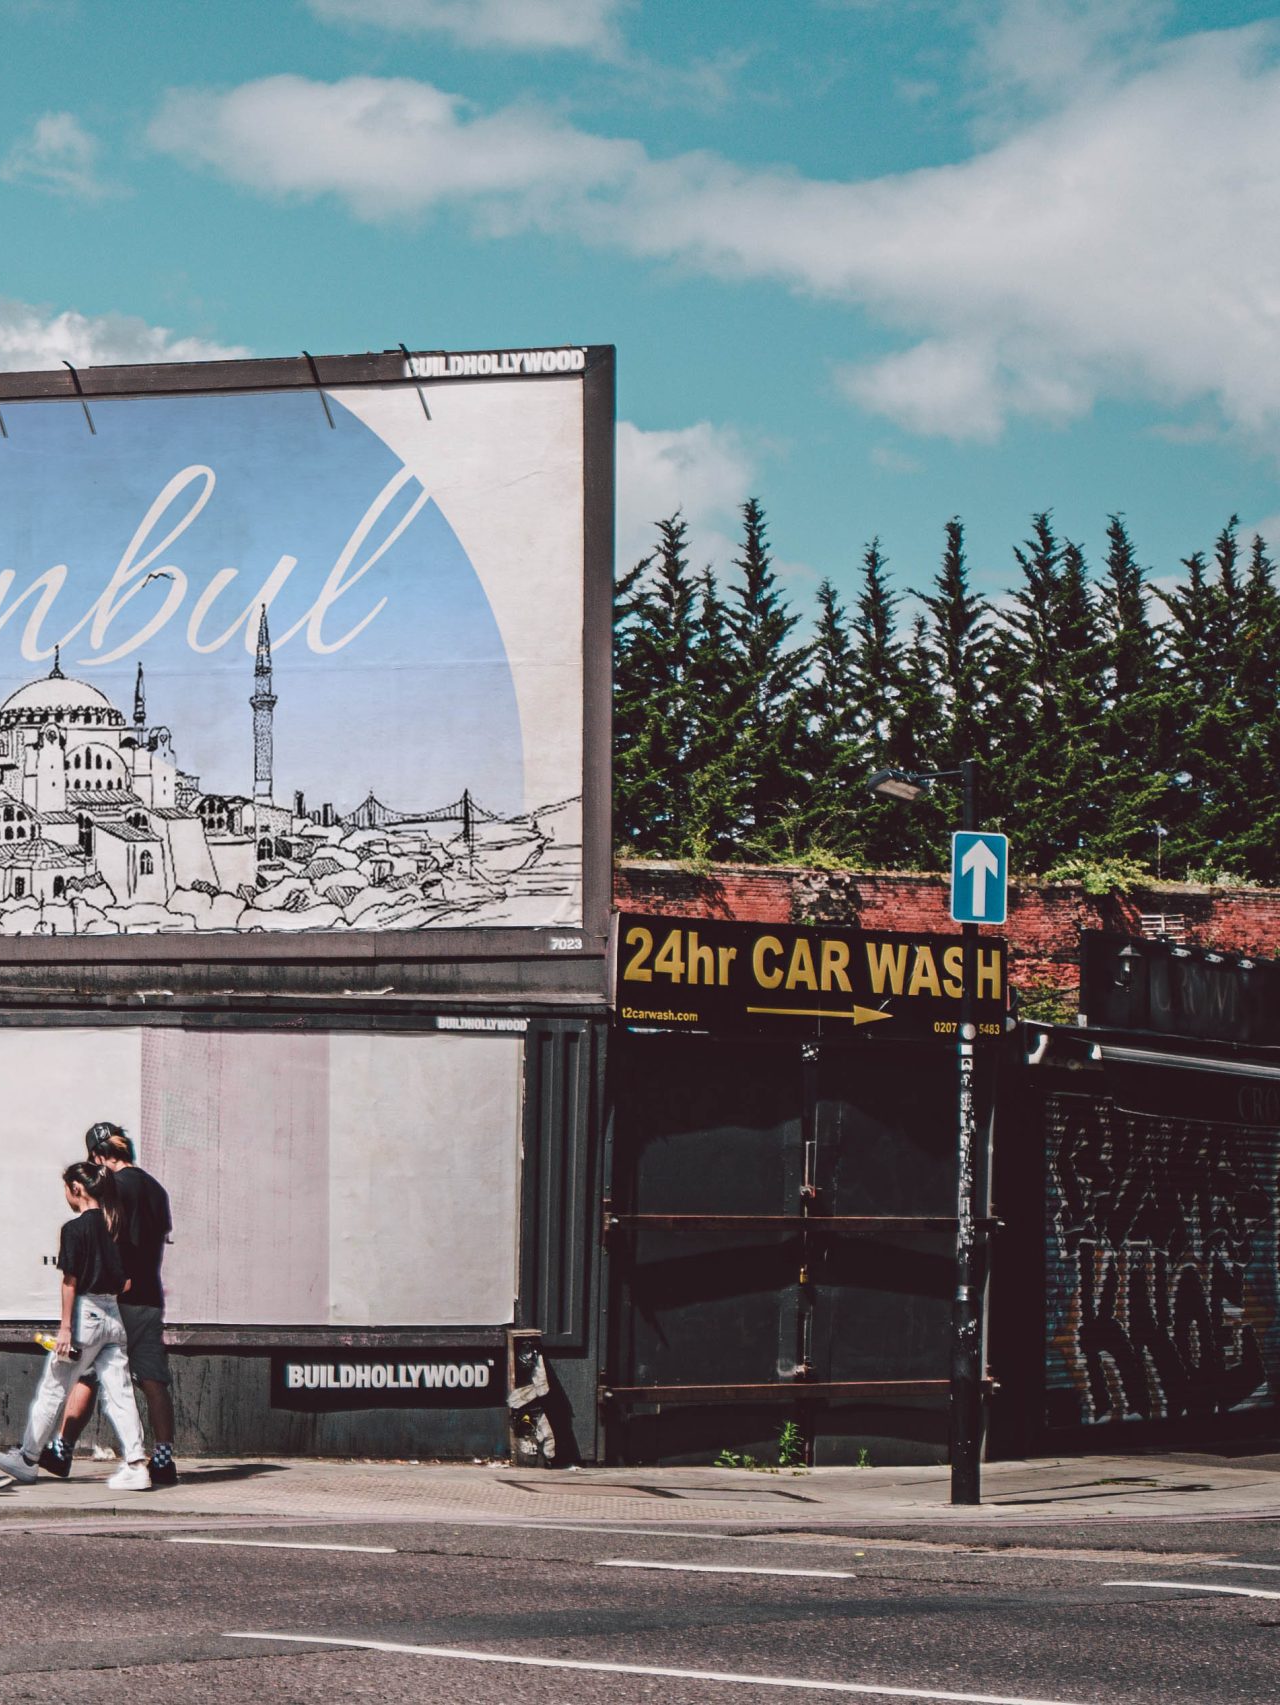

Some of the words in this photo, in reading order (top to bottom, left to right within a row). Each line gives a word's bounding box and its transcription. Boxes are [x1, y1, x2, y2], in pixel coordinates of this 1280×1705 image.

[404, 350, 585, 377] BUILDHOLLYWOOD
[550, 938, 583, 950] 7023
[623, 927, 737, 985] 24hr
[752, 936, 853, 992] CAR
[865, 942, 1001, 999] WASH
[622, 1007, 698, 1021] t2carwash.com
[437, 1016, 528, 1031] BUILDHOLLYWOOD
[933, 1022, 958, 1033] 0207
[979, 1023, 1001, 1035] 5483
[287, 1364, 490, 1388] BUILDHOLLYWOOD
